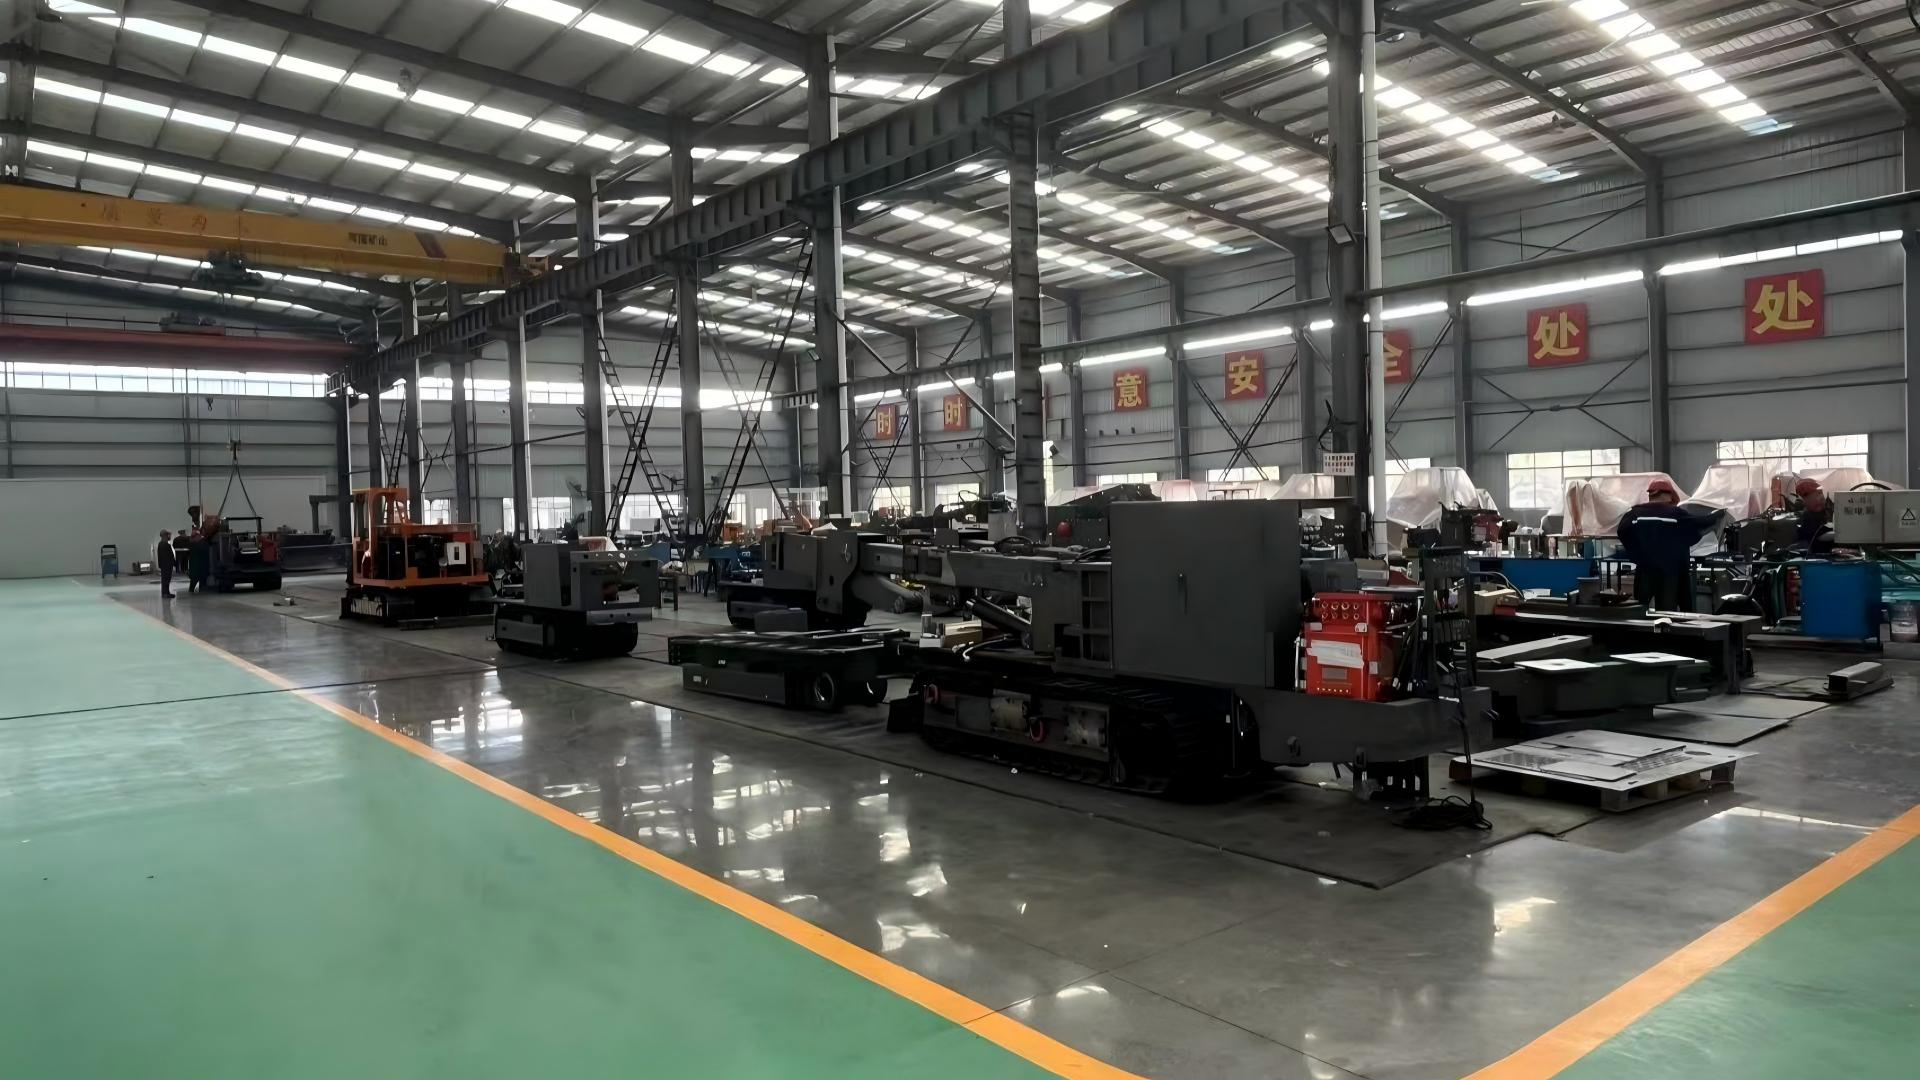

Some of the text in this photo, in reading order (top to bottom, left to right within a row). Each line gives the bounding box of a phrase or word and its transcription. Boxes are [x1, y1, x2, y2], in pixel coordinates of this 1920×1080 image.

[877, 407, 893, 435] 时
[944, 397, 963, 426] 时
[1116, 373, 1142, 407] 意
[1228, 356, 1259, 394] 安
[1533, 312, 1580, 360] 处
[1752, 280, 1814, 335] 处
